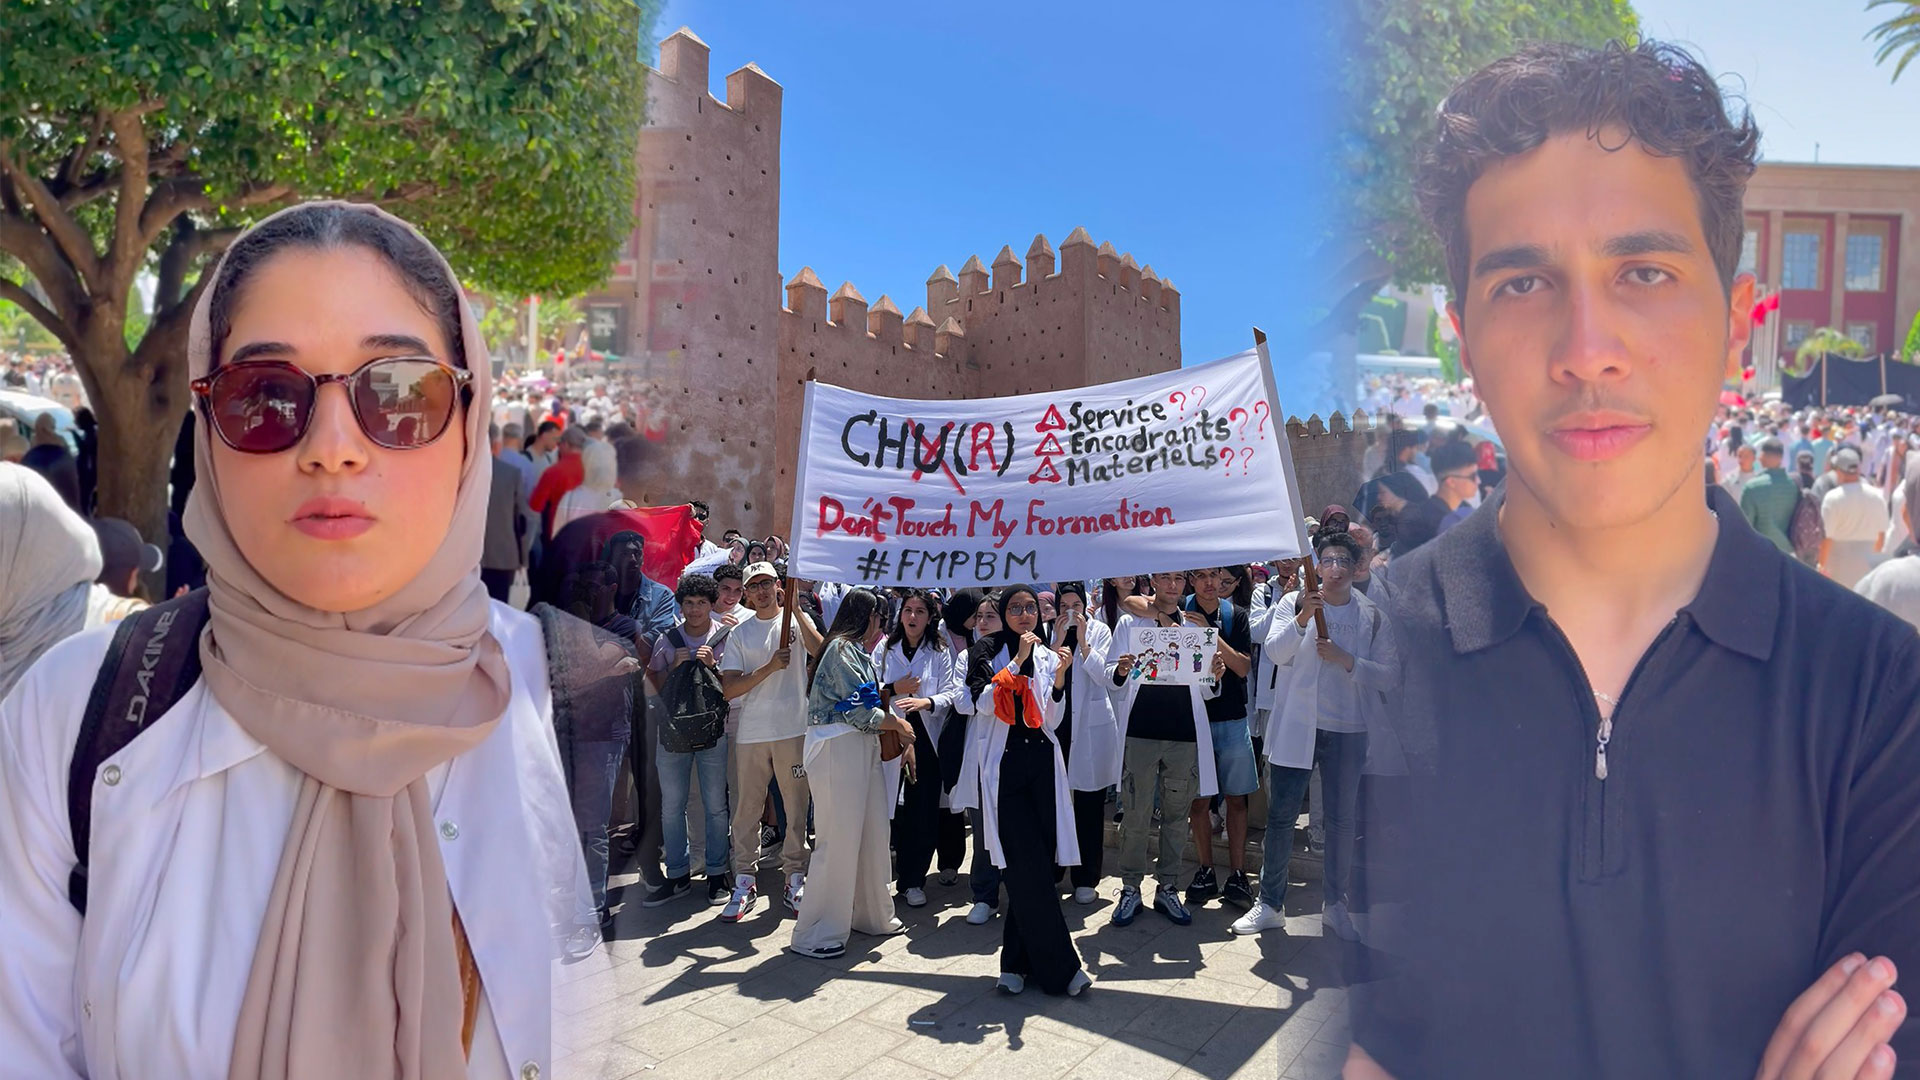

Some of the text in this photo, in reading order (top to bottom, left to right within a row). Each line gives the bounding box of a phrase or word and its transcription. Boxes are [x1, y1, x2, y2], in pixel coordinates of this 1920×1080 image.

[817, 496, 1176, 549] Don't Touch My Formation
[857, 548, 1040, 582] #FMPBM
[125, 607, 180, 727] DAKINE
